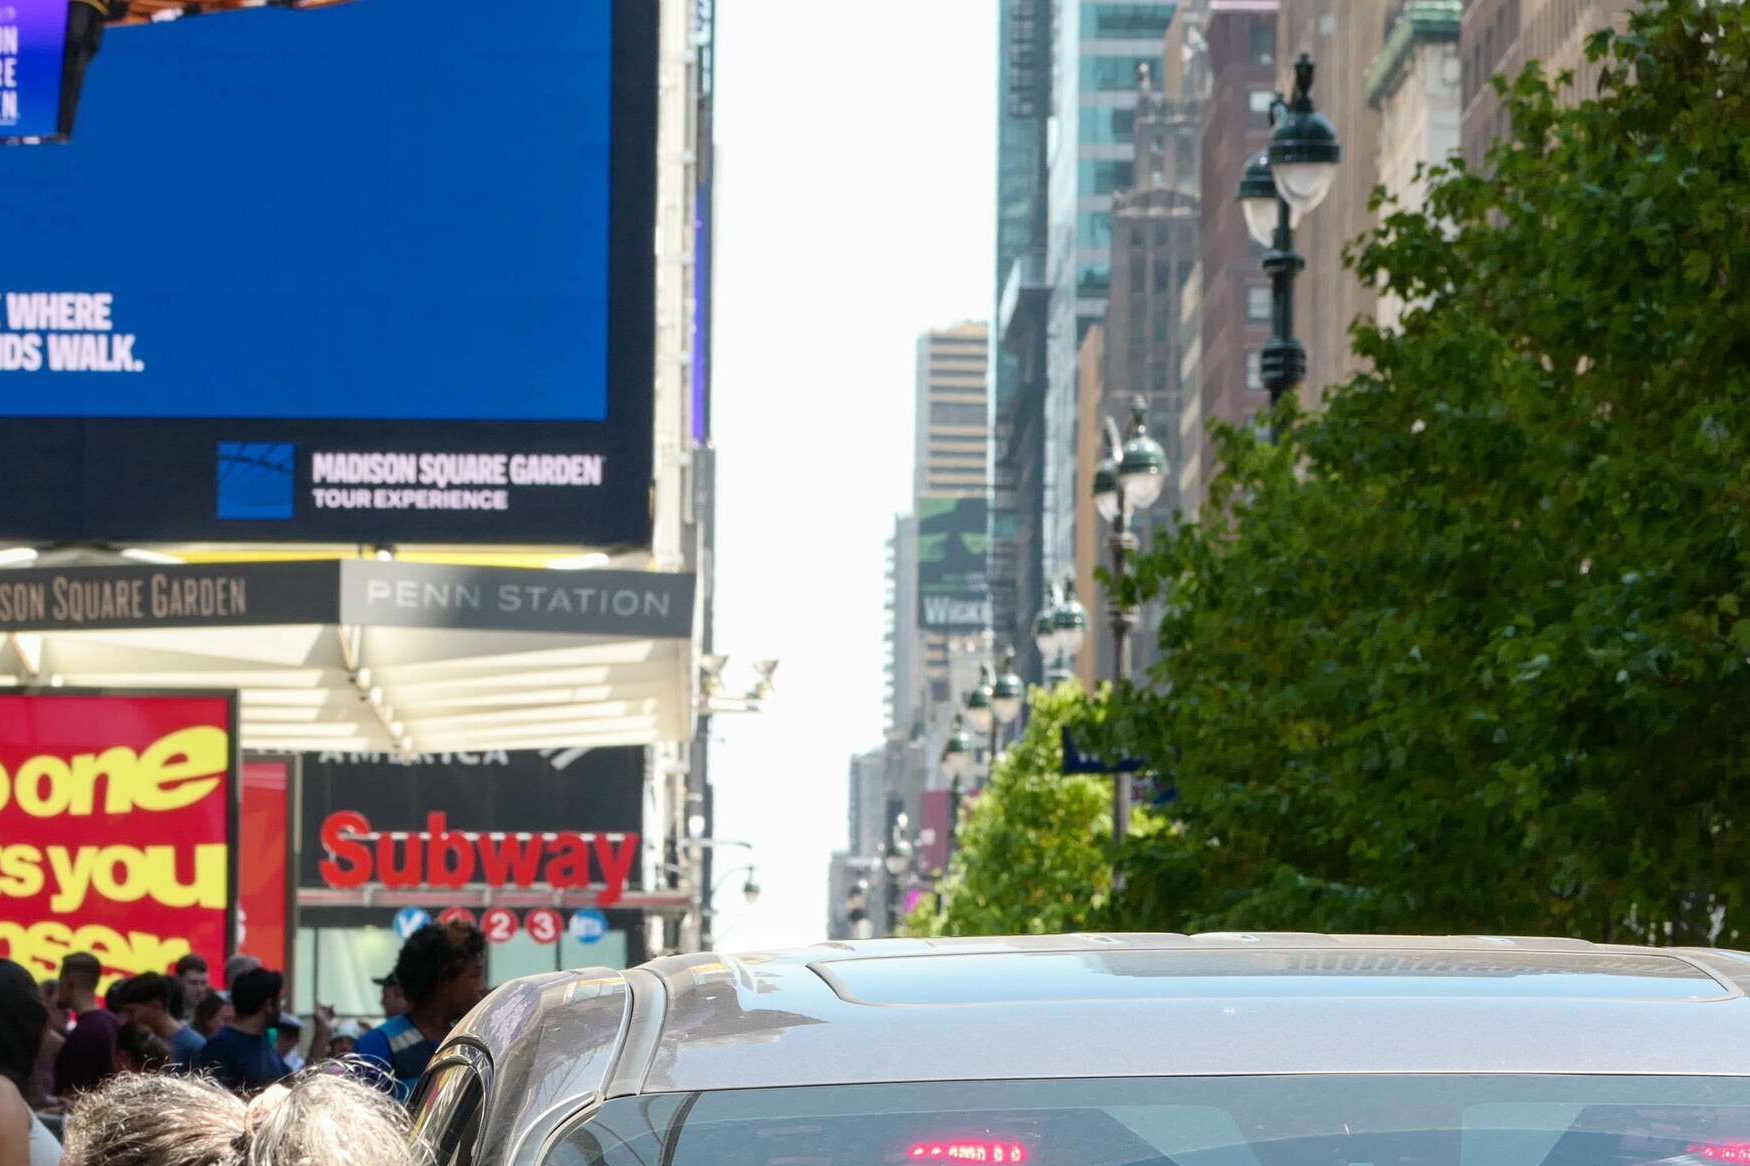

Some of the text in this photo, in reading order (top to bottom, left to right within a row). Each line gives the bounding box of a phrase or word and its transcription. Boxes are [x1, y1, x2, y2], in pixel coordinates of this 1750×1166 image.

[6, 292, 112, 330] WHERE
[47, 334, 145, 371] WALK.
[312, 453, 602, 488] MADISON SQUARE GARDEN
[312, 489, 508, 510] TOUR EXPERIENCE
[52, 576, 143, 622] SQUARE
[151, 574, 246, 618] GARDEN
[367, 580, 670, 617] PENN STATION
[14, 726, 228, 817] one
[319, 810, 639, 906] Subway
[46, 843, 228, 913] you
[489, 912, 511, 939] 2
[532, 912, 555, 940] 3
